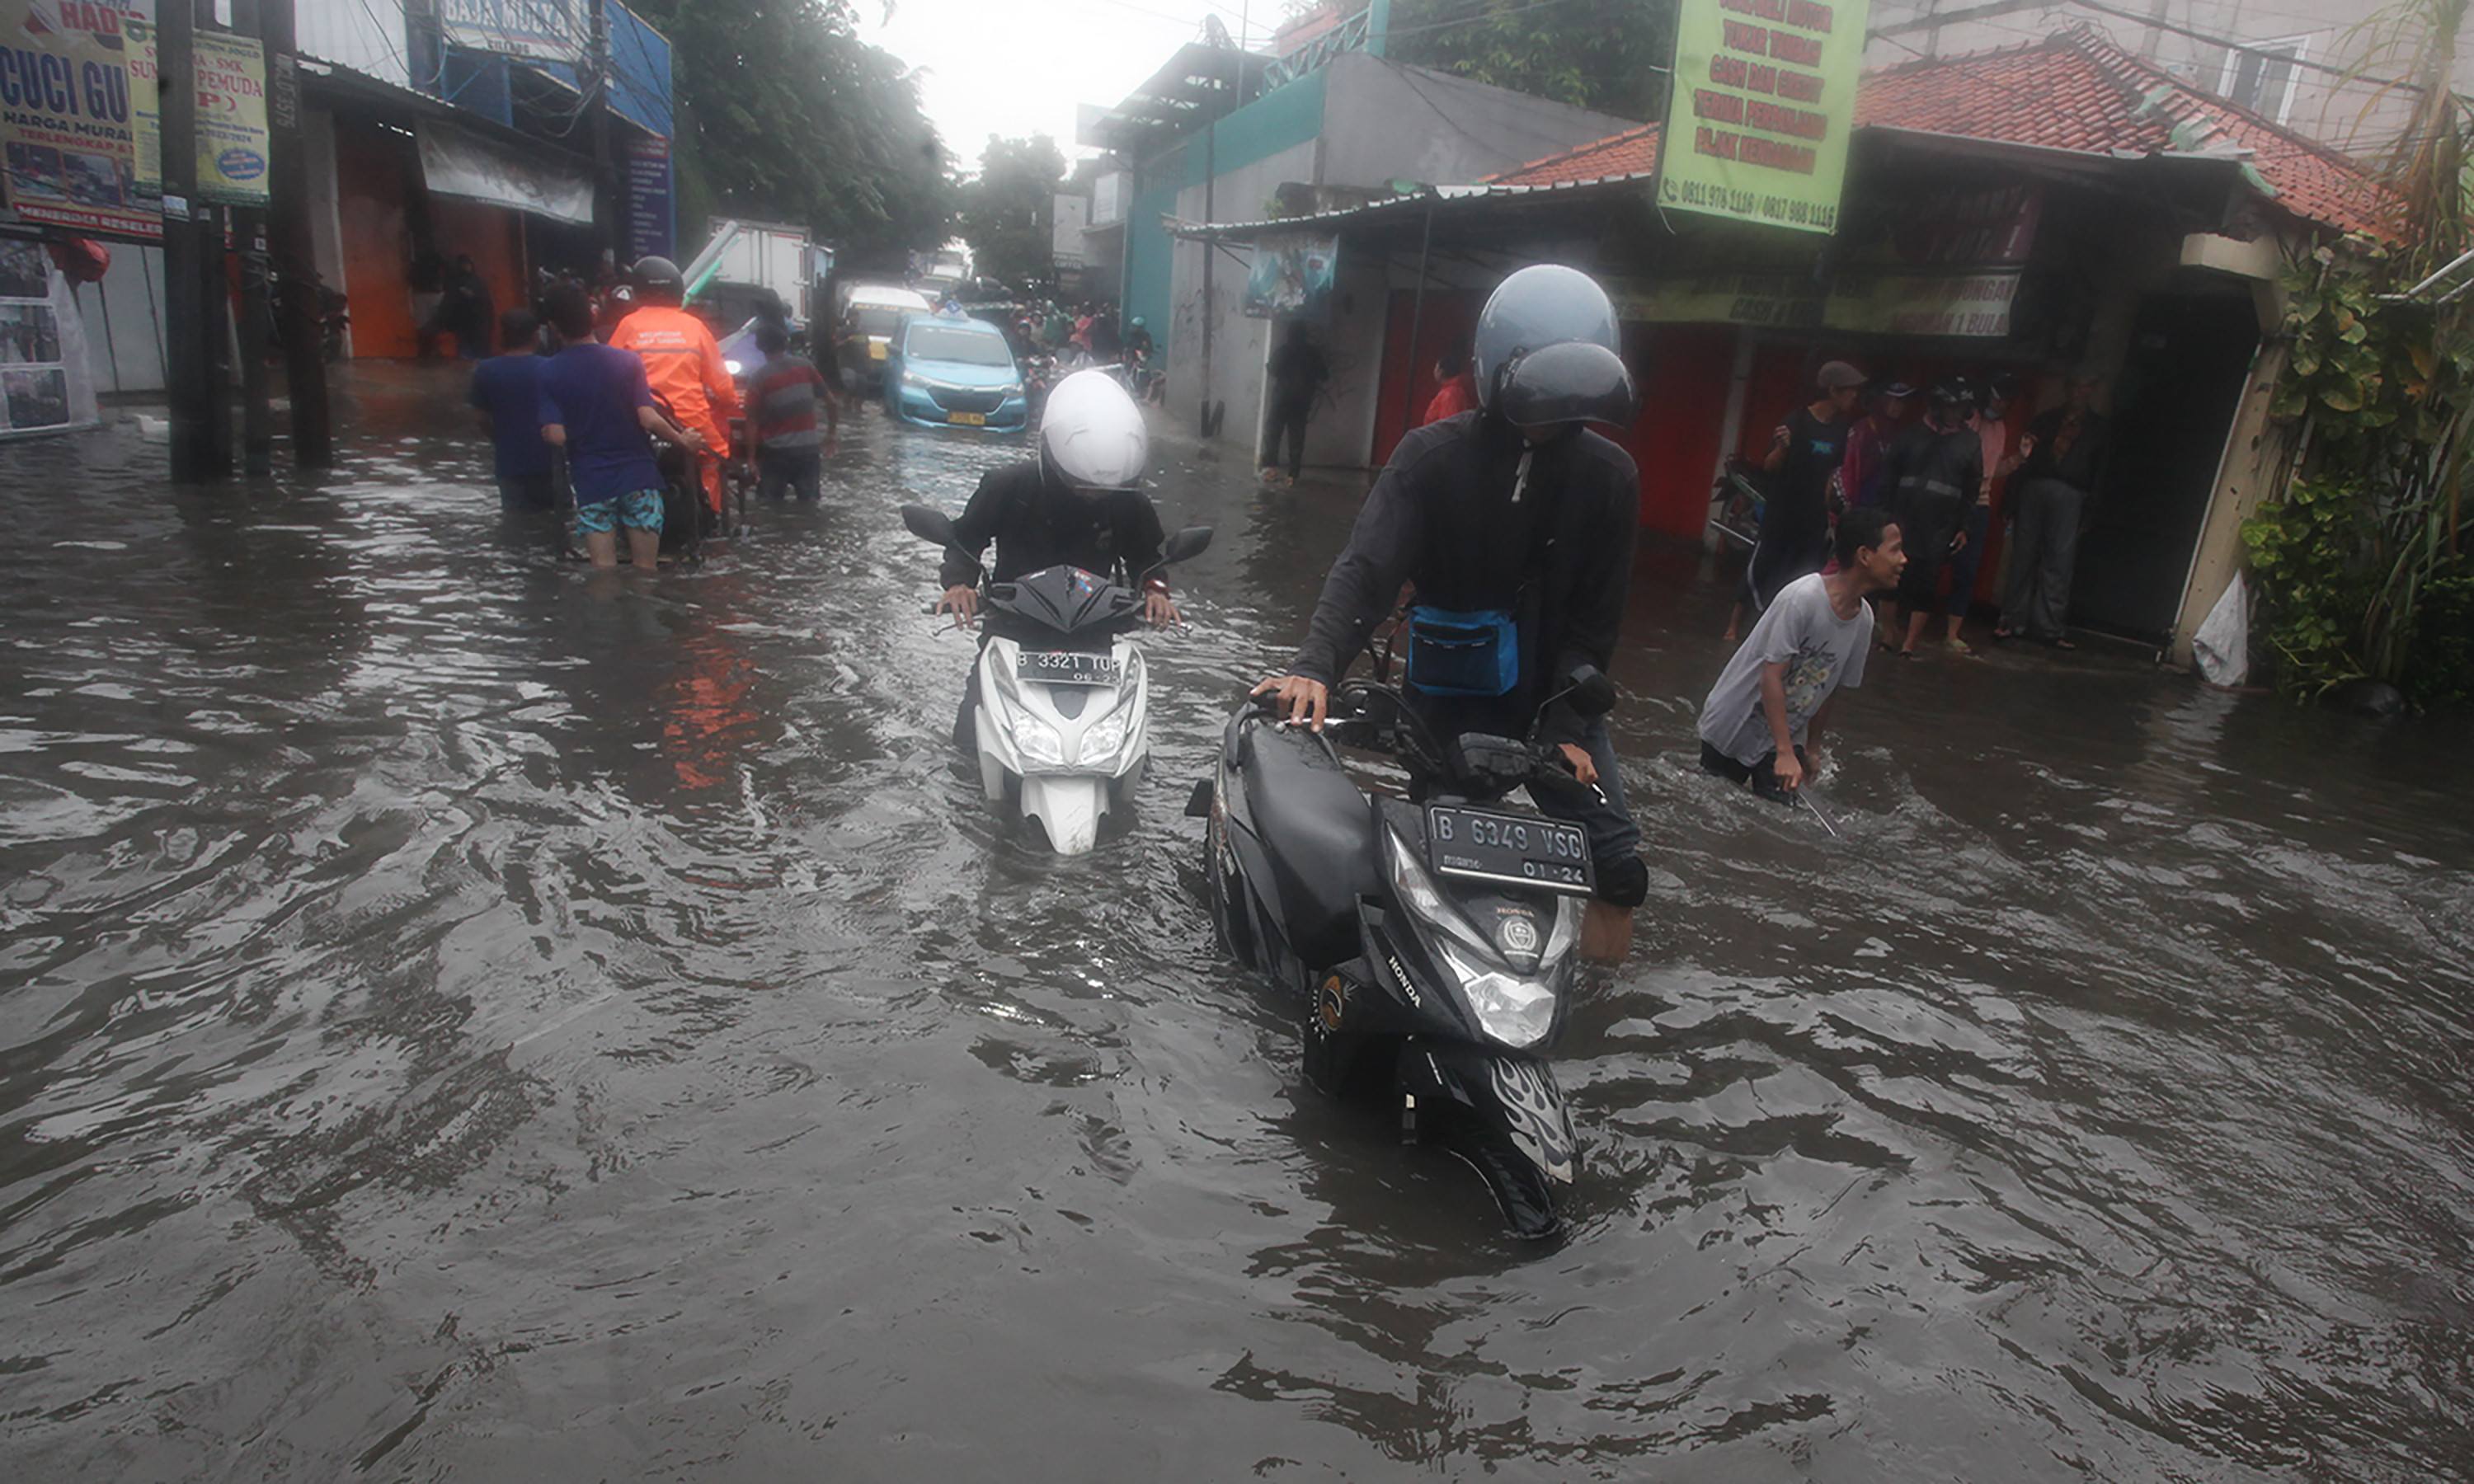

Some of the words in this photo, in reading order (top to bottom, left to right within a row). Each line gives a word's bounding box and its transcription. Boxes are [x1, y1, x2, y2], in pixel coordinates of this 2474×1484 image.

[444, 0, 496, 27] BAJA
[1723, 18, 1768, 56] TUKAR
[0, 45, 79, 116] CUCI
[82, 59, 130, 124] GU
[196, 68, 264, 98] PEMUDA
[1709, 54, 1748, 89] CASH
[1747, 62, 1777, 95] DAN
[3, 110, 70, 133] HARGA
[1693, 88, 1744, 125] TERIMA
[18, 128, 115, 151] TERLENGKAP
[1695, 125, 1740, 162] PAJAK
[1729, 189, 1755, 214] 1116
[1017, 652, 1028, 667] B
[1038, 652, 1079, 669] 3321
[1439, 815, 1454, 840] B
[1472, 819, 1529, 851] 6349
[1540, 829, 1582, 859] VSG
[1497, 908, 1536, 918] HONDA
[1389, 955, 1422, 1009] HONDA
